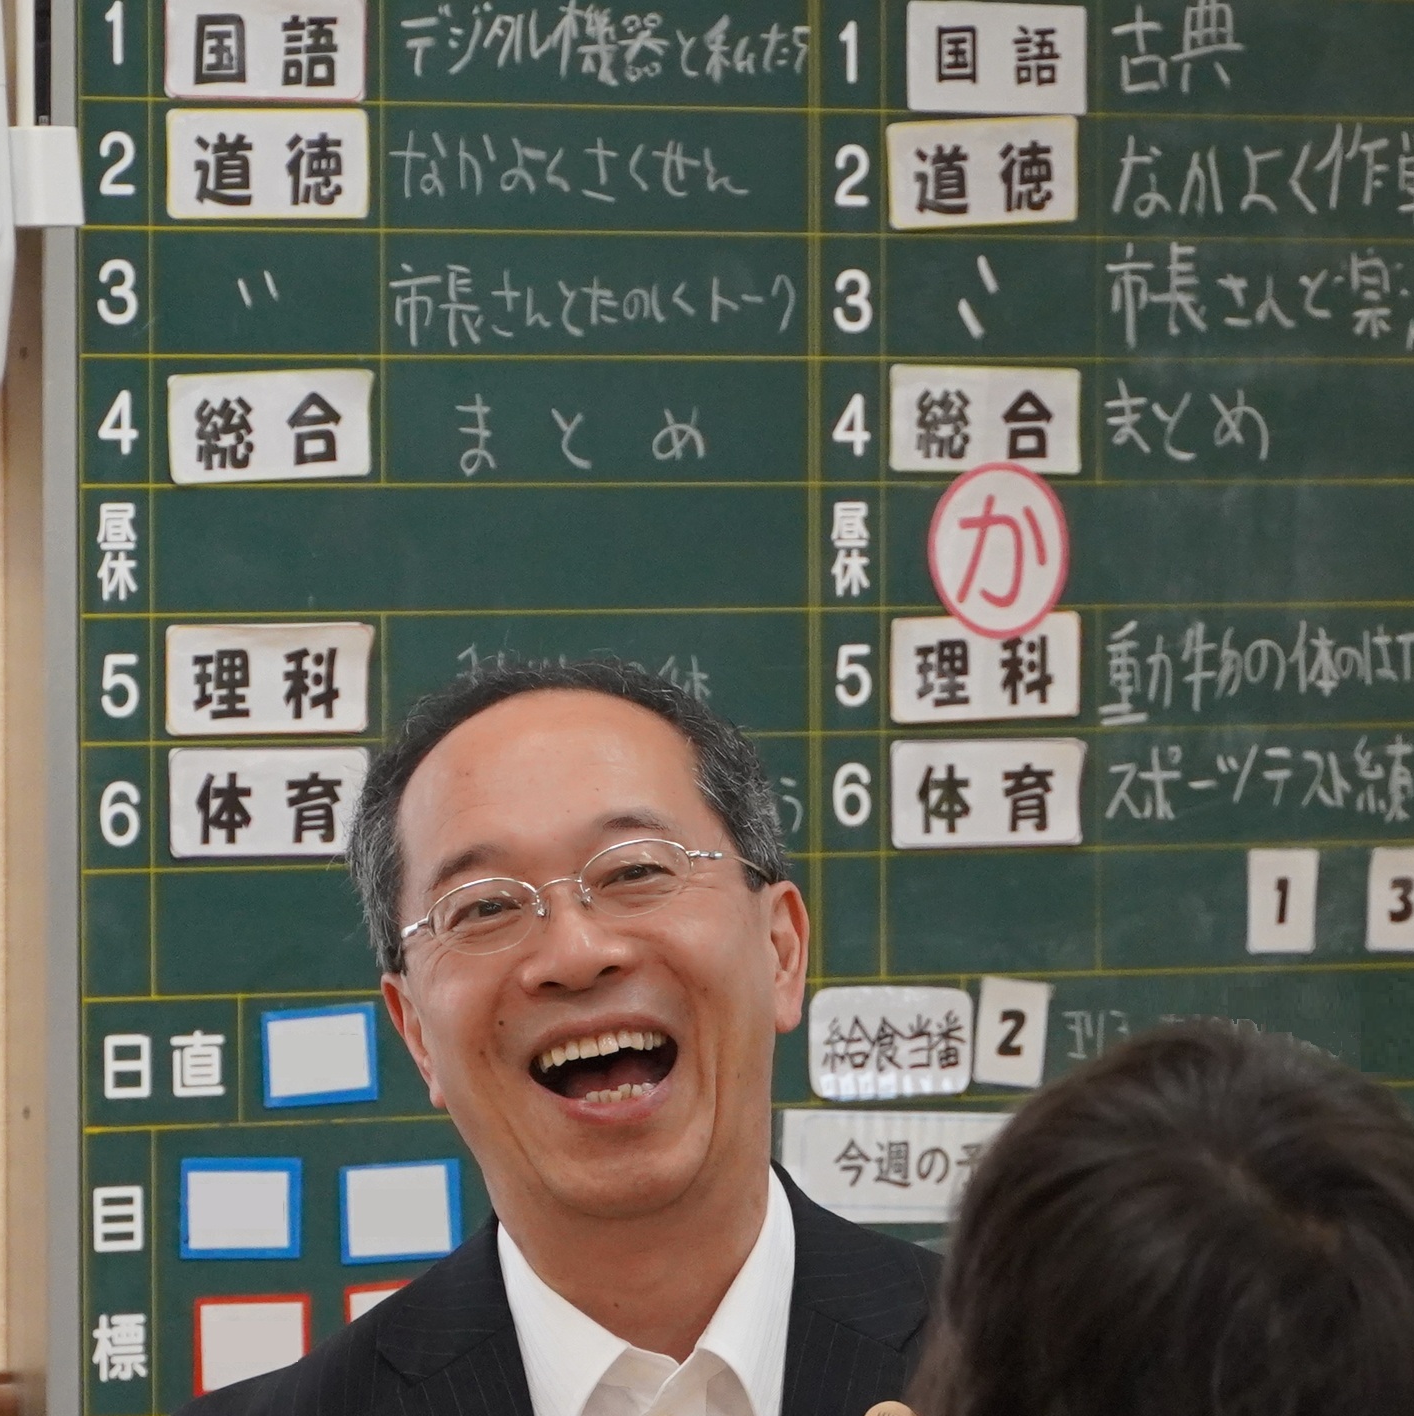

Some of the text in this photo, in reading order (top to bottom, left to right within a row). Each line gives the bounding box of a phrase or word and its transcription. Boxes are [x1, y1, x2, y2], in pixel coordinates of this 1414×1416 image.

[104, 1, 125, 64] 1
[193, 14, 338, 87] 国語
[837, 20, 858, 84] 1
[936, 24, 1062, 87] 国語
[1111, 0, 1245, 93] 古典
[98, 131, 136, 196] 2
[194, 132, 344, 206] 道徳
[389, 130, 749, 202] なかよくさくせん
[834, 143, 871, 208] 2
[914, 140, 1053, 214] 道徳
[97, 259, 138, 325] 3
[832, 270, 871, 333] 3
[98, 390, 139, 454] 4
[195, 392, 341, 471] 総合
[455, 394, 707, 477] まとめ
[832, 394, 871, 455] 4
[915, 390, 1053, 459] 総合
[1106, 379, 1271, 461] まとめ
[97, 503, 138, 600] 昼休
[831, 501, 871, 597] 昼休
[957, 495, 1047, 607] か
[101, 653, 139, 718] 5
[192, 648, 340, 720] 理科
[835, 644, 872, 707] 5
[915, 635, 1053, 707] 理科
[99, 781, 140, 847] 6
[196, 772, 342, 845] 体育
[832, 762, 872, 827] 6
[918, 763, 1054, 833] 体育
[1277, 878, 1290, 924] 1
[1389, 877, 1414, 923] 3
[103, 1030, 225, 1099] 日直
[822, 1010, 966, 1071] 給食当番
[996, 1010, 1025, 1056] 2
[93, 1185, 147, 1382] 目標
